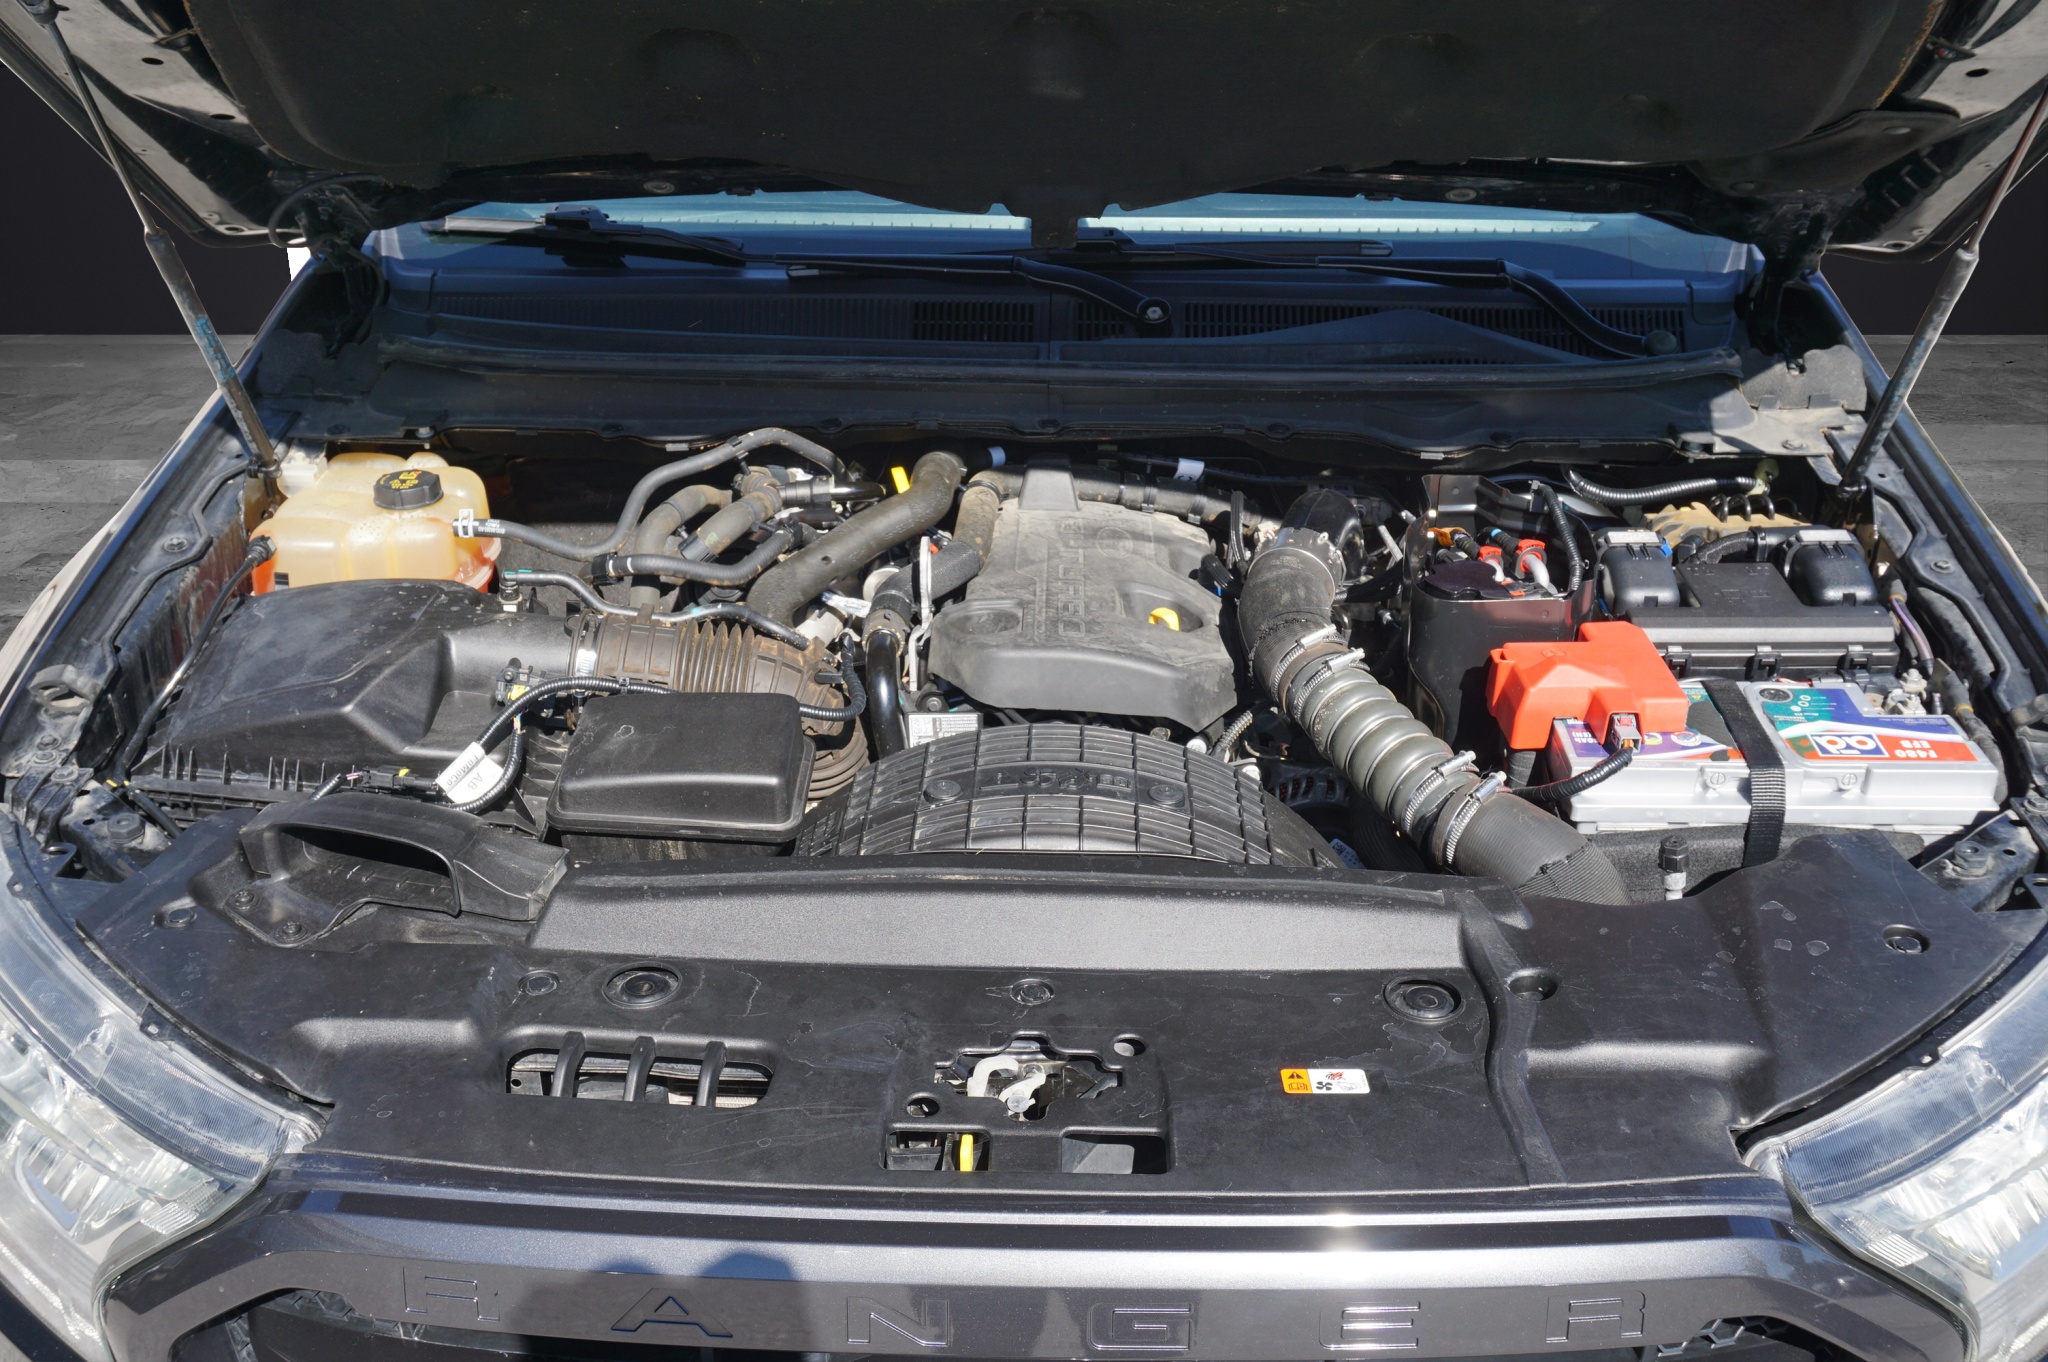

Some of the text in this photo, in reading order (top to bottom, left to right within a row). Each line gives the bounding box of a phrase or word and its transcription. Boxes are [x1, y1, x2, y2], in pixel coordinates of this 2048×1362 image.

[1899, 739, 1932, 749] EFB
[1893, 749, 1939, 759] F480
[467, 772, 484, 791] AB
[402, 1267, 1646, 1351] RANGER
